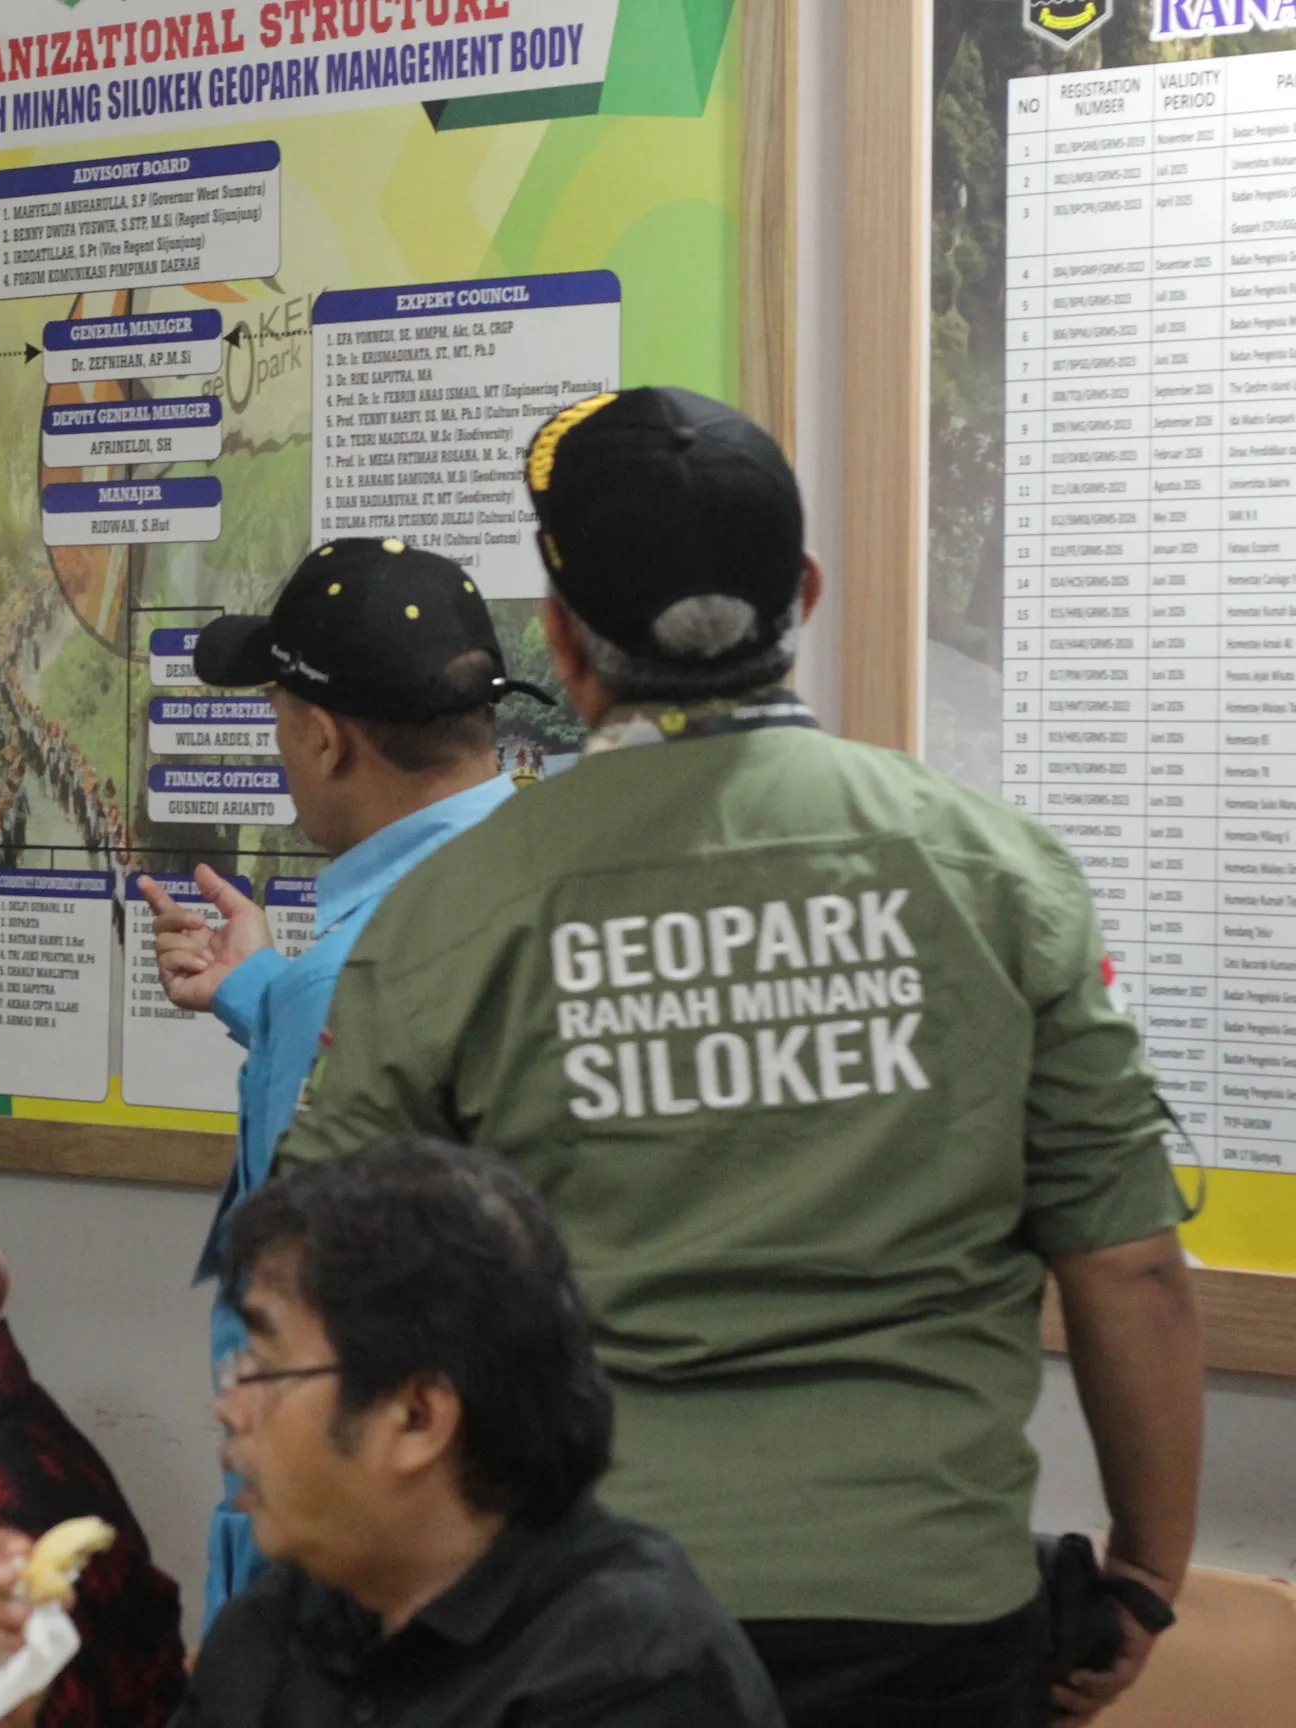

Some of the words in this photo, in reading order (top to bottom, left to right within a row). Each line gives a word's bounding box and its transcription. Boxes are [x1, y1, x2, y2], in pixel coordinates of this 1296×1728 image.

[1157, 0, 1296, 35] RANA
[12, 83, 101, 131] MINANG
[107, 68, 204, 121] SILOKEK
[208, 55, 321, 108] GEOPARK
[325, 33, 504, 94] MANAGEMENT
[510, 22, 585, 73] BODY
[1159, 70, 1221, 90] VALIDITY
[1060, 78, 1141, 99] REGISTRATION
[1017, 98, 1041, 114] NO
[1074, 98, 1126, 117] NUMBER
[1163, 91, 1216, 111] PERIOD
[73, 160, 140, 184] ADVISORY
[142, 156, 190, 178] BOARD
[1023, 176, 1030, 188] 2
[148, 189, 193, 209] (Governor
[196, 187, 219, 203] West
[222, 181, 266, 200] Sumatra)
[13, 224, 43, 242] BENNY
[151, 214, 173, 230] M.Si
[175, 210, 209, 229] (Regent
[211, 205, 262, 226] Sijunjung)
[99, 241, 121, 259] (Vice
[123, 240, 154, 258] Regent
[156, 234, 205, 255] Sijunjung)
[13, 270, 45, 286] FORUM
[48, 264, 107, 284] KOMUNIKASI
[109, 260, 158, 279] PIMPINAN
[160, 256, 201, 274] DAERAH
[1022, 269, 1030, 280] 4
[395, 291, 455, 312] EXPERT
[457, 286, 529, 307] COUNCIL
[1023, 300, 1030, 312] 5
[70, 321, 129, 342] GENERAL
[129, 317, 193, 337] MANAGER
[71, 357, 86, 373] Dr.
[87, 352, 146, 372] ZEFNIHAN,
[1022, 362, 1029, 374] 7
[417, 367, 433, 382] MA
[418, 388, 444, 402] ANAS
[483, 384, 500, 398] MT
[561, 379, 602, 395] Planning
[52, 409, 96, 427] DEPUTY
[97, 406, 151, 424] GENERAL
[153, 402, 212, 421] MANAGER
[90, 440, 154, 457] AFRINELDI,
[156, 438, 172, 453] SH
[1018, 454, 1031, 466] 10
[98, 485, 163, 505] MANAJER
[1018, 486, 1031, 497] 11
[90, 519, 140, 535] RIDWAN,
[141, 517, 170, 533] S.Hut
[1018, 516, 1031, 528] 12
[1017, 547, 1030, 559] 13
[1017, 578, 1030, 590] 14
[1017, 609, 1030, 621] 15
[1016, 640, 1030, 652] 16
[1016, 670, 1029, 682] 17
[161, 703, 192, 719] HEAD
[193, 703, 209, 719] OF
[1015, 701, 1029, 713] 18
[175, 731, 211, 747] WILDA
[213, 732, 254, 749] ARDES,
[255, 732, 270, 747] ST
[1015, 732, 1028, 744] 19
[1014, 763, 1028, 775] 20
[164, 771, 222, 788] FINANCE
[222, 772, 280, 789] OFFICER
[168, 800, 219, 816] GUSNEDI
[221, 800, 275, 817] ARIANTO
[1014, 795, 1027, 806] 21
[550, 887, 917, 994] GEOPARK
[557, 985, 720, 1041] RANAH
[728, 965, 923, 1024] MINANG
[562, 1011, 932, 1121] SILOKEK
